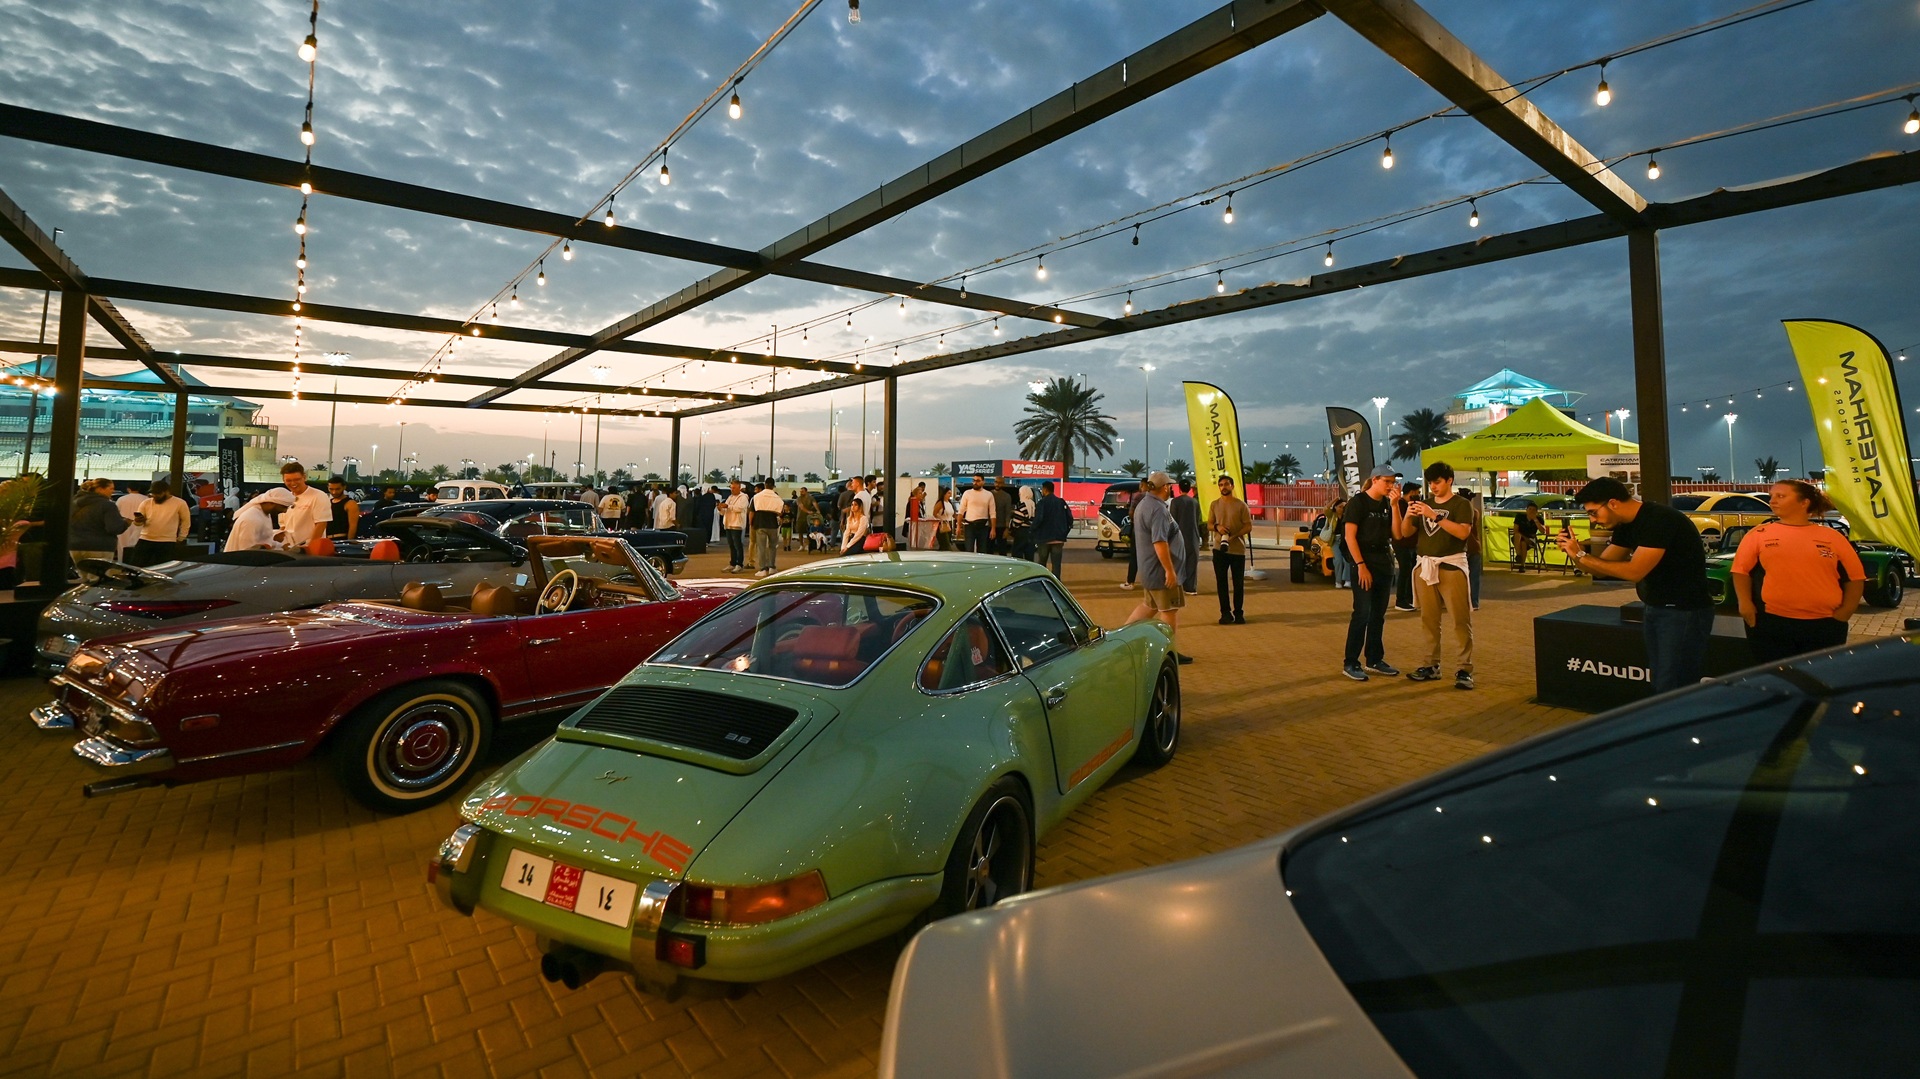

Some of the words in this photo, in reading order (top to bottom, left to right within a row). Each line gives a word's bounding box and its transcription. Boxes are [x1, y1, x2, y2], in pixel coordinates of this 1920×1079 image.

[1473, 432, 1573, 440] CATERHAM
[1464, 453, 1565, 462] rmamotors.com/caterham
[958, 463, 976, 474] YAS
[1011, 463, 1033, 474] YAS
[477, 795, 693, 874] PORSCHE
[518, 863, 535, 886] 14
[598, 886, 614, 910] ١٤
